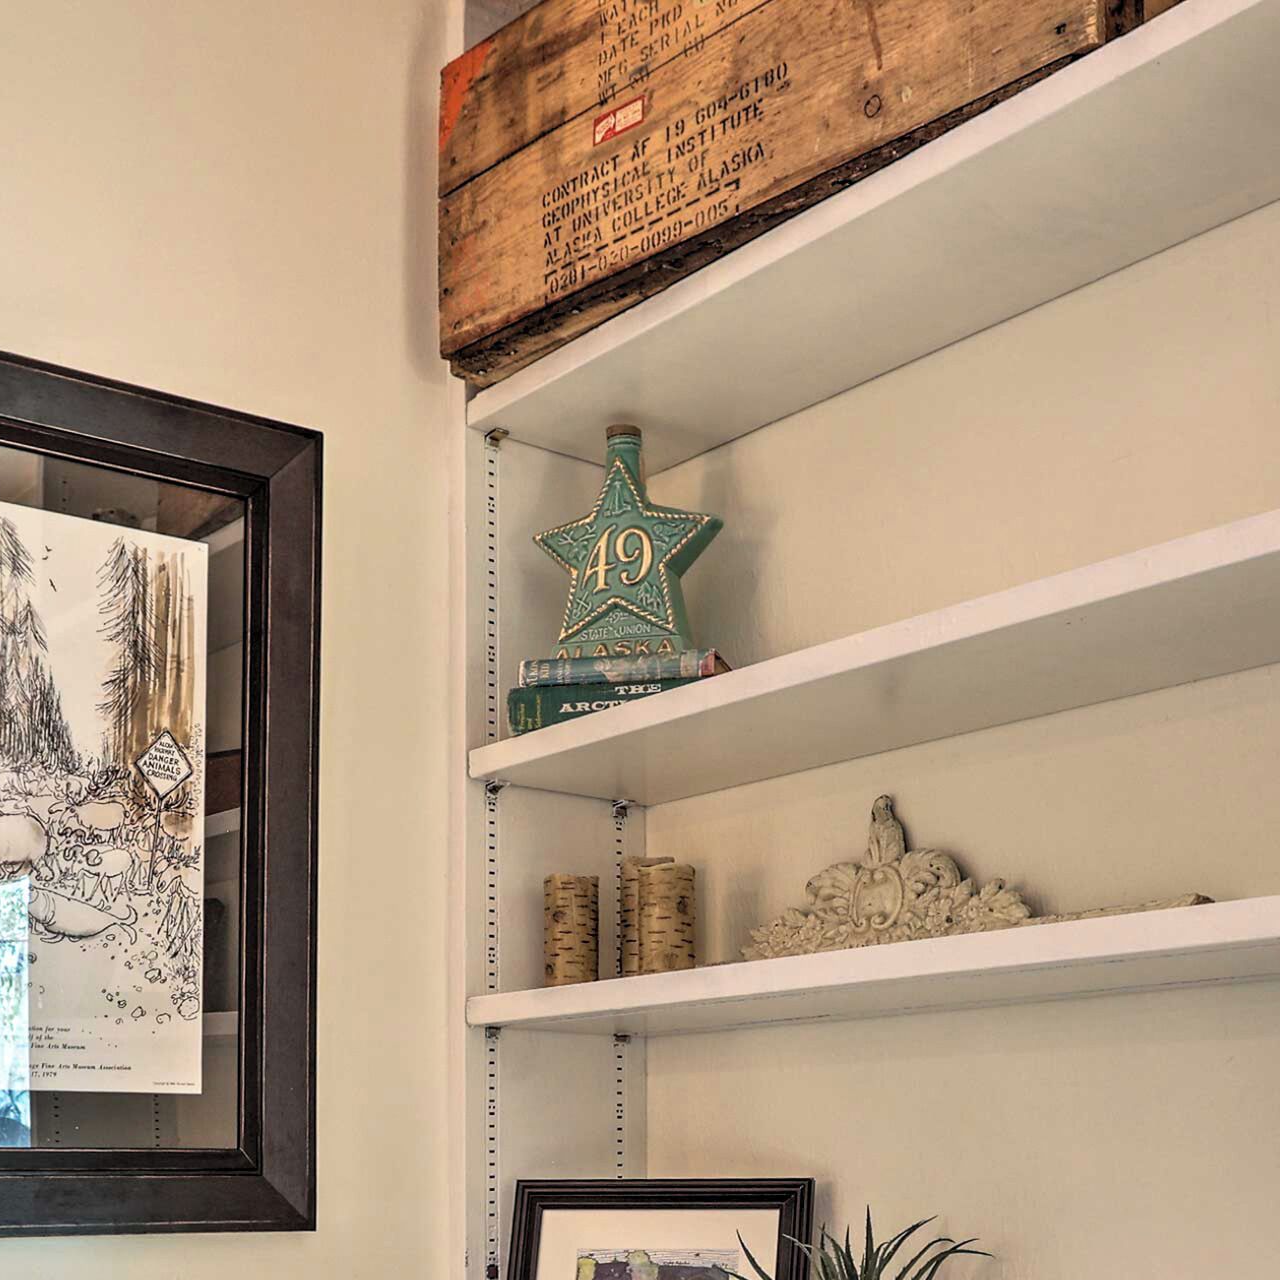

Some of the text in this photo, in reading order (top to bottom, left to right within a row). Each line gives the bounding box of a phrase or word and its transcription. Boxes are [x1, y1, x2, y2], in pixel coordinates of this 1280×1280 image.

[598, 30, 639, 66] DATE
[640, 14, 705, 62] SERIAL
[542, 161, 651, 228] GEOPHYSICAL
[667, 98, 764, 163] INSTITUTE
[542, 154, 620, 208] CONTRACT
[631, 136, 651, 161] AF
[665, 119, 685, 143] 19
[543, 148, 709, 248] AT UNIVERSITY OF
[545, 141, 765, 267] ALASKA COLLEGE ALASKA
[580, 523, 653, 594] 49
[580, 623, 651, 640] STATE UNION
[559, 700, 628, 713] ARCT
[614, 683, 662, 694] THE
[142, 760, 181, 776] ANIMALS
[146, 769, 178, 782] CROSSING
[148, 752, 180, 766] DANGER
